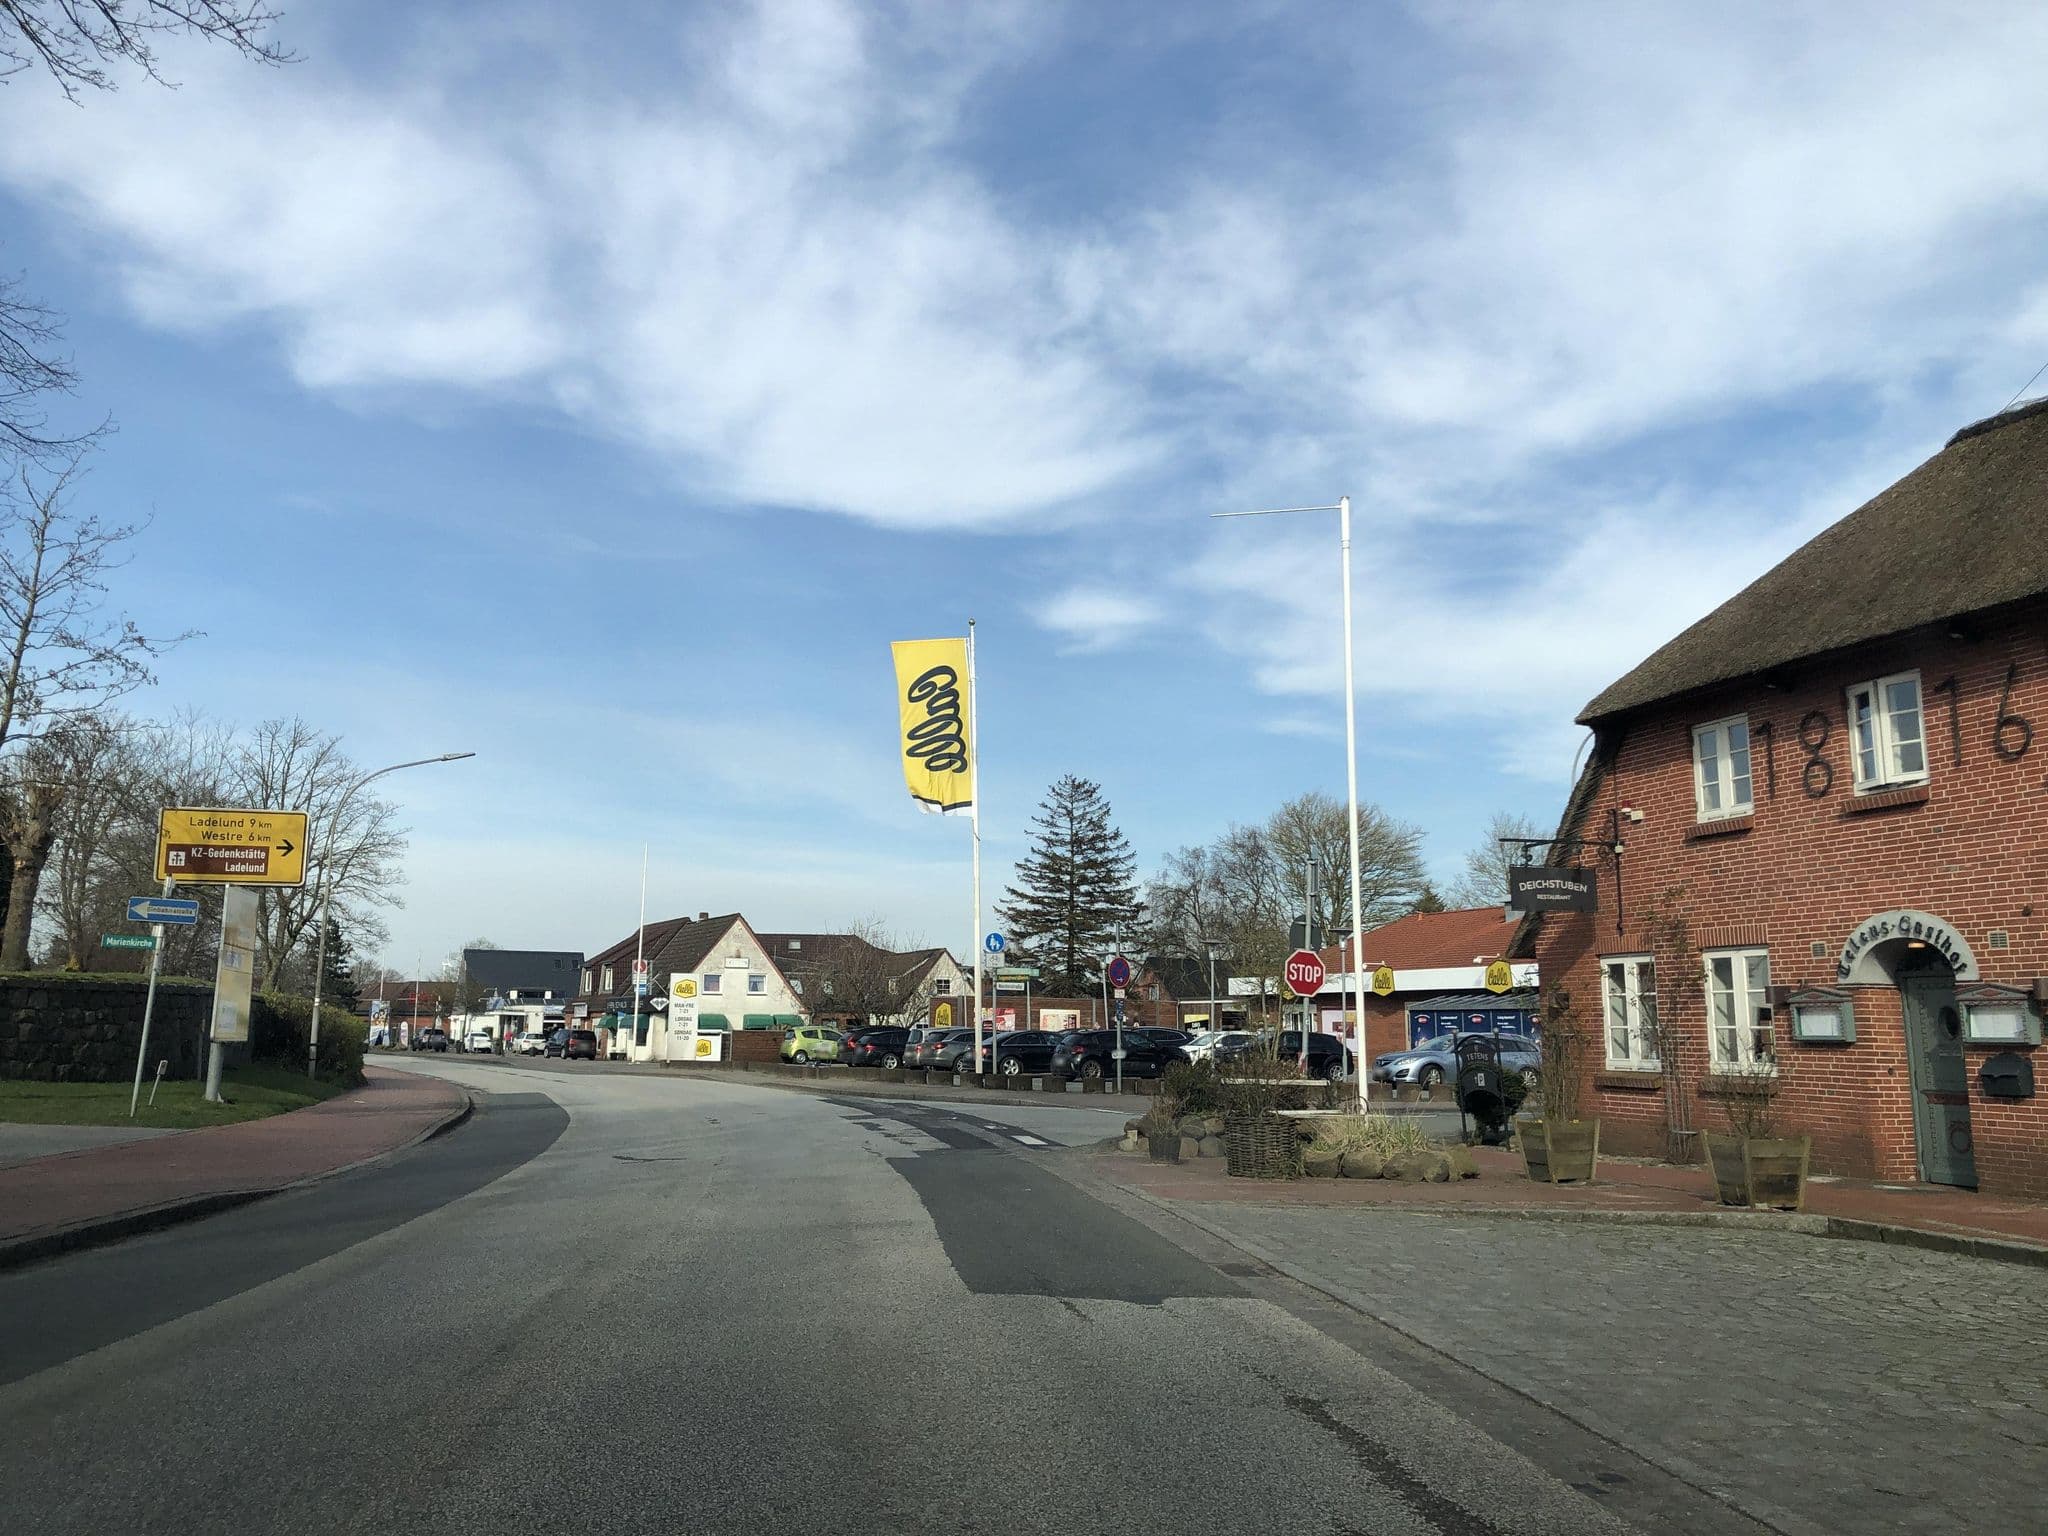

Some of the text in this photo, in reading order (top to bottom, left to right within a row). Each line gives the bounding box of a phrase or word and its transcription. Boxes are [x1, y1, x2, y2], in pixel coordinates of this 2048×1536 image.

[189, 816, 272, 829] Ladelund 9 km
[201, 830, 272, 842] Westre 6 km
[191, 847, 266, 860] KZ-Gedenkstätte
[225, 861, 265, 873] Ladelund
[1518, 879, 1588, 893] DEICHSTUBEN
[106, 936, 153, 948] Marienkirche
[1288, 963, 1322, 984] STOP
[1488, 967, 1508, 986] Calle
[1466, 1052, 1489, 1061] TETENS
